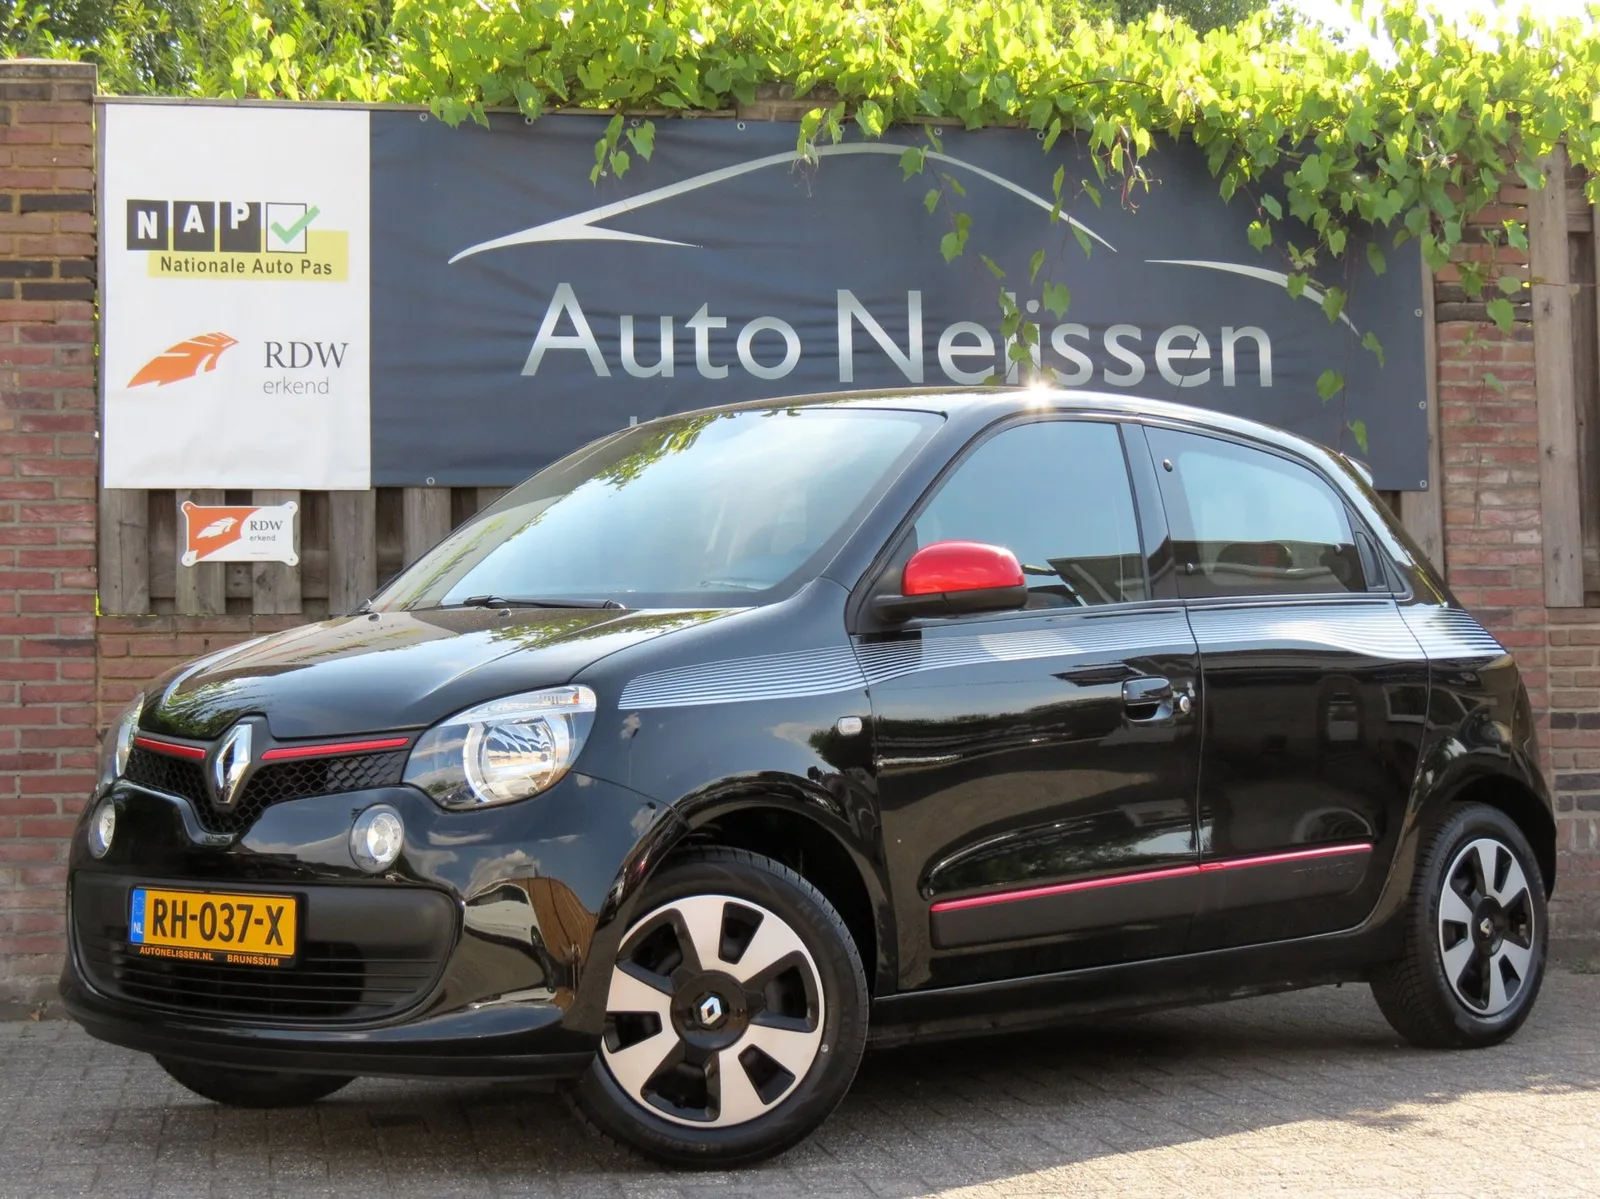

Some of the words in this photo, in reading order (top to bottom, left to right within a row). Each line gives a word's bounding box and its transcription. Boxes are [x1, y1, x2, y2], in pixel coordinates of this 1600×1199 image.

[137, 201, 250, 240] NAP
[160, 256, 246, 273] Nationale
[252, 258, 293, 274] Auto
[301, 259, 332, 275] Pas
[520, 282, 801, 380] Auto
[837, 289, 1273, 388] Nelissen
[263, 341, 349, 369] RDW
[263, 376, 329, 395] erkend
[250, 520, 283, 531] RDW
[249, 534, 276, 542] erkend
[133, 922, 144, 934] NL
[152, 898, 284, 946] RH-037-X
[139, 946, 214, 961] AUTONELISSEN.NL
[227, 954, 279, 966] BRUNSSUM
